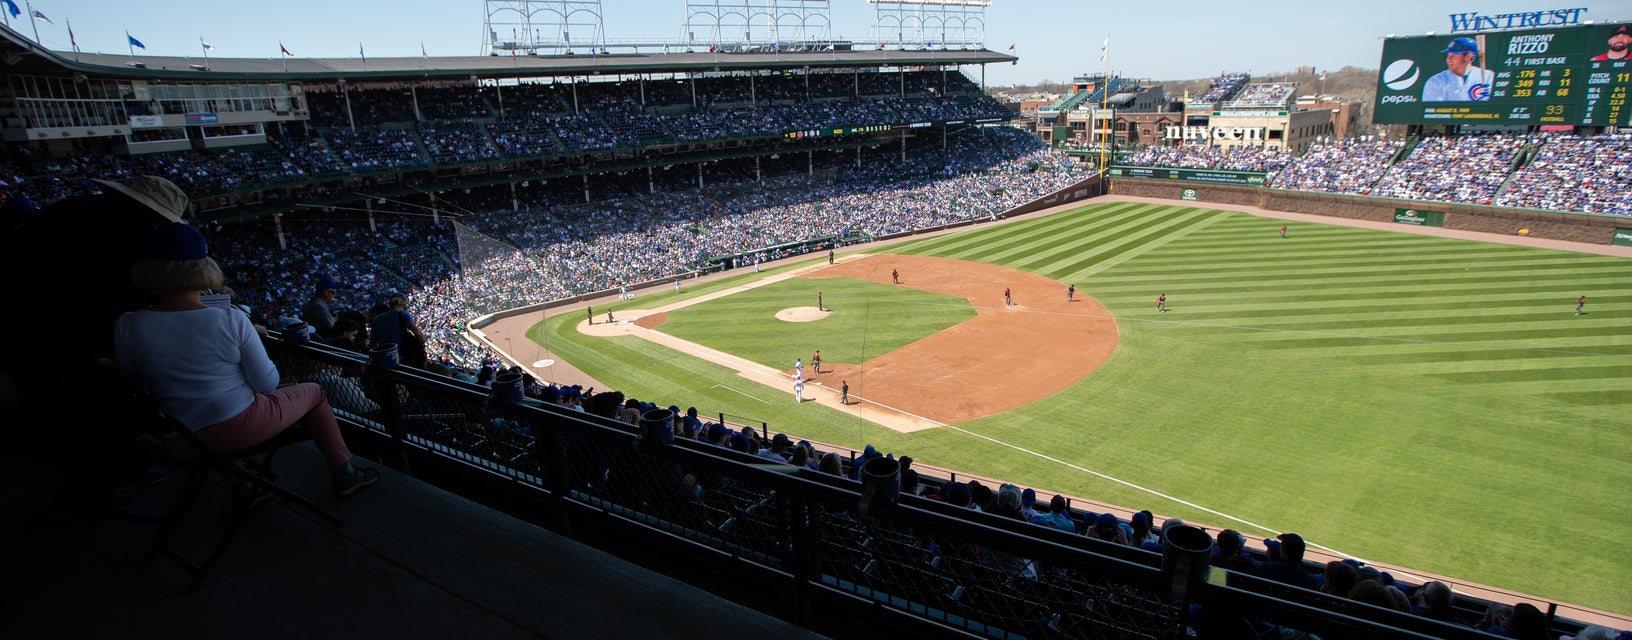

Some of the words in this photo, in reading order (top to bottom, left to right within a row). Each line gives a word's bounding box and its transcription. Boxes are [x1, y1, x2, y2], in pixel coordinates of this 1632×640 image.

[1448, 8, 1588, 32] WINTRUST
[1510, 34, 1555, 44] ANTHONY
[1508, 42, 1549, 55] RIZZO
[1504, 58, 1521, 66] 44
[1564, 68, 1571, 77] 3
[1560, 78, 1571, 87] 11
[1618, 74, 1630, 82] 11
[1512, 88, 1532, 97] .353
[1556, 88, 1569, 97] 68
[1382, 96, 1416, 104] pepsi
[1546, 106, 1564, 115] 93
[1165, 125, 1263, 140] nuveen
[1247, 175, 1265, 184] xfinity
